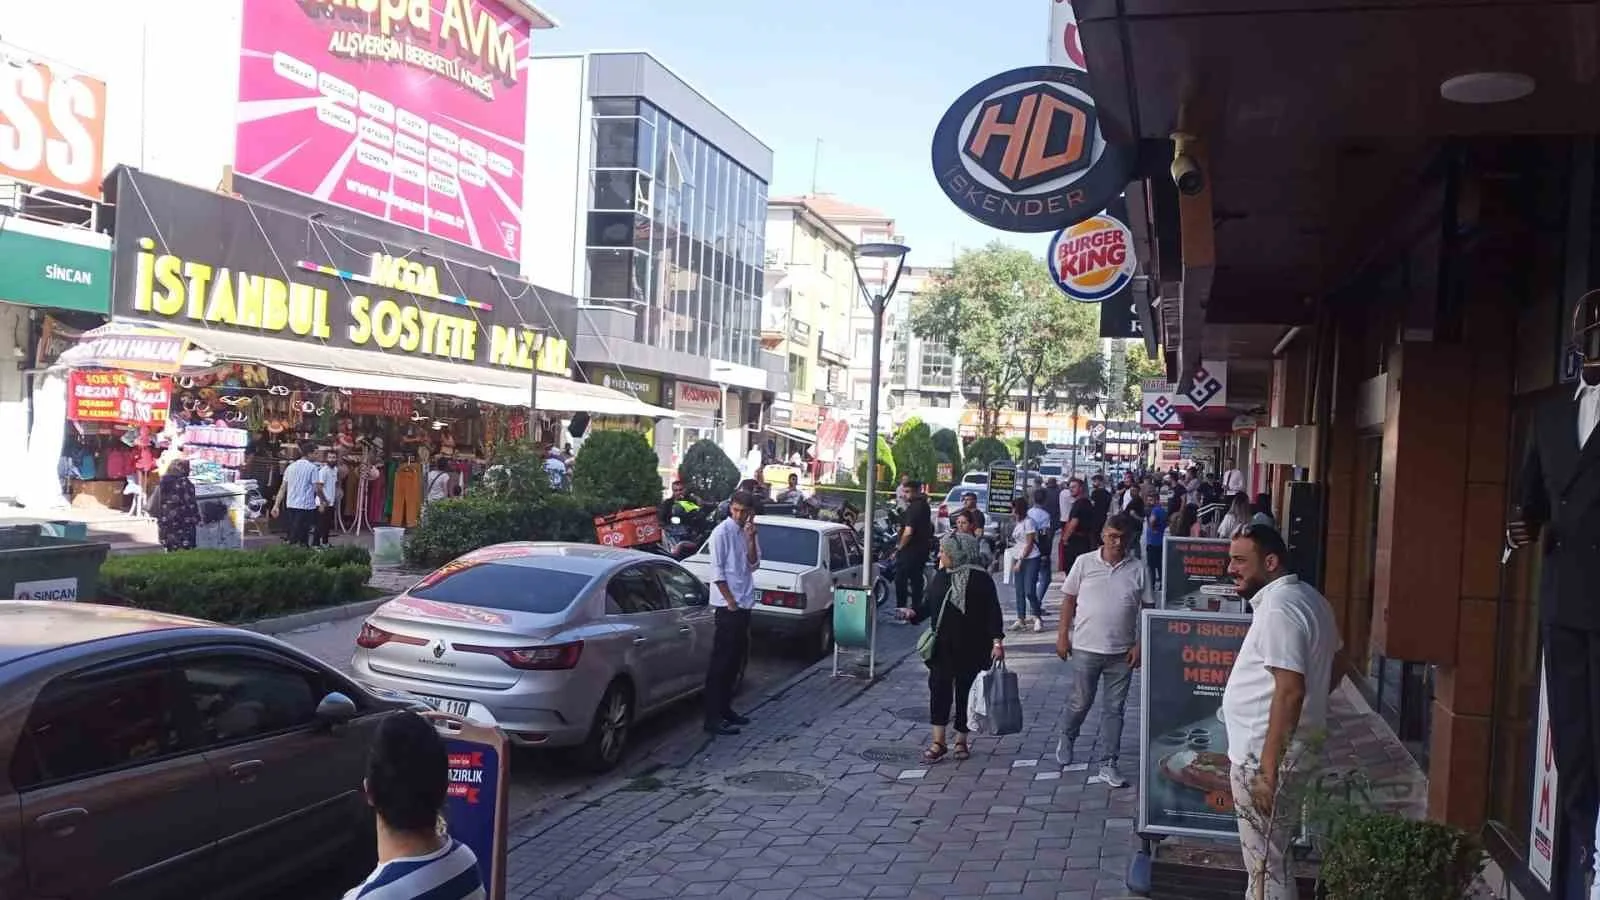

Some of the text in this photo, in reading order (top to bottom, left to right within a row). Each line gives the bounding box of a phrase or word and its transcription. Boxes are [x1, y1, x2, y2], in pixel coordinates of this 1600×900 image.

[969, 92, 1087, 181] HD
[1058, 229, 1125, 261] BURGER
[45, 264, 92, 285] SİNCAN
[1059, 242, 1127, 283] KING
[134, 237, 331, 339] İSTANBUL
[349, 295, 477, 361] SOSYETE
[1168, 621, 1191, 634] HD
[1182, 645, 1238, 666] ÖĞRE
[448, 768, 483, 783] AZIRLIK
